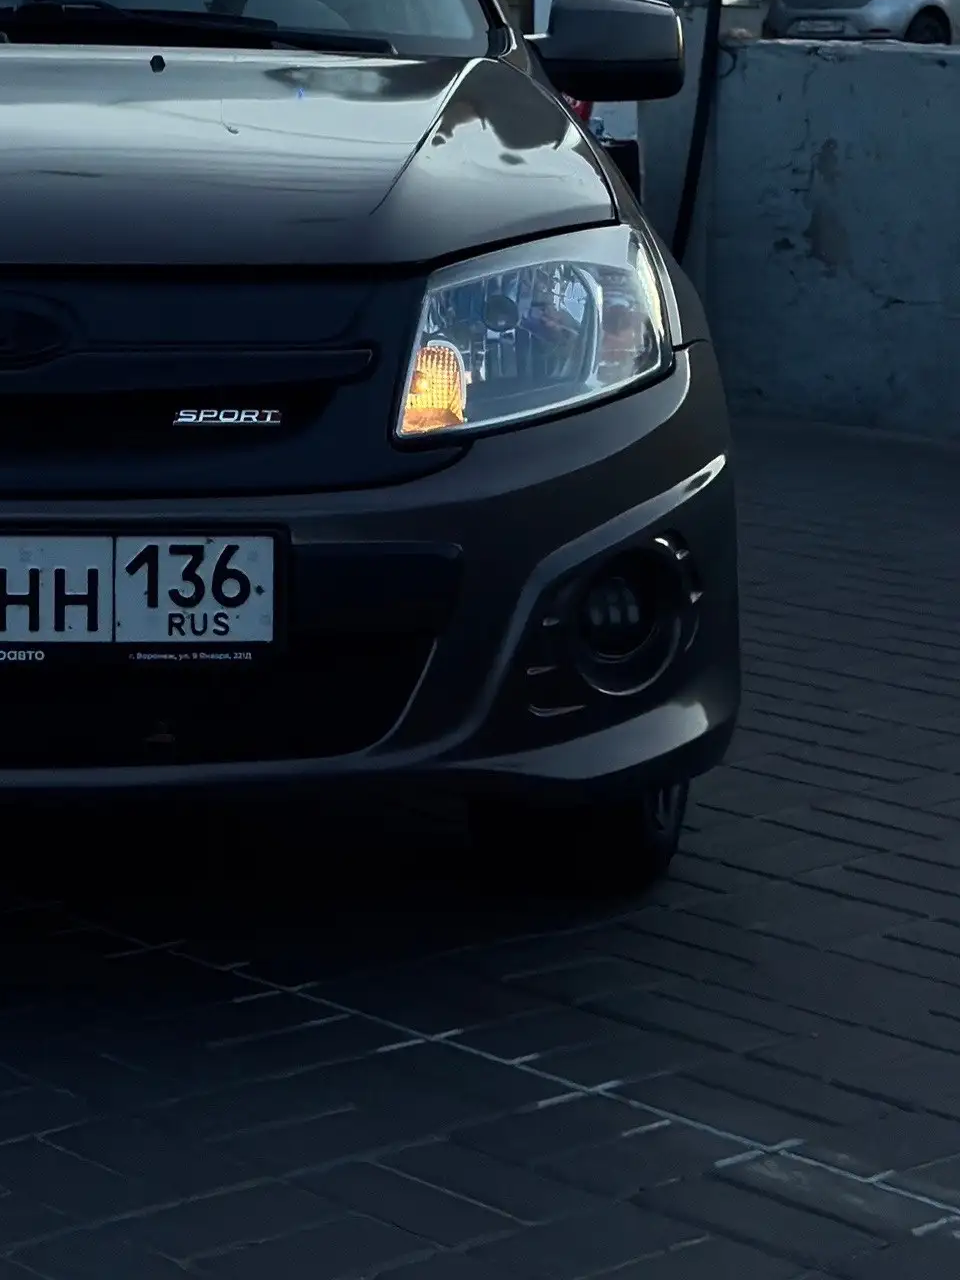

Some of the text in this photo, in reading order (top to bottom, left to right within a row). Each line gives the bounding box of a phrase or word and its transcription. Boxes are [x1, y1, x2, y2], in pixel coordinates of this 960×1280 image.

[176, 409, 281, 424] SPORT
[125, 544, 251, 609] 136
[167, 612, 230, 637] RUS
